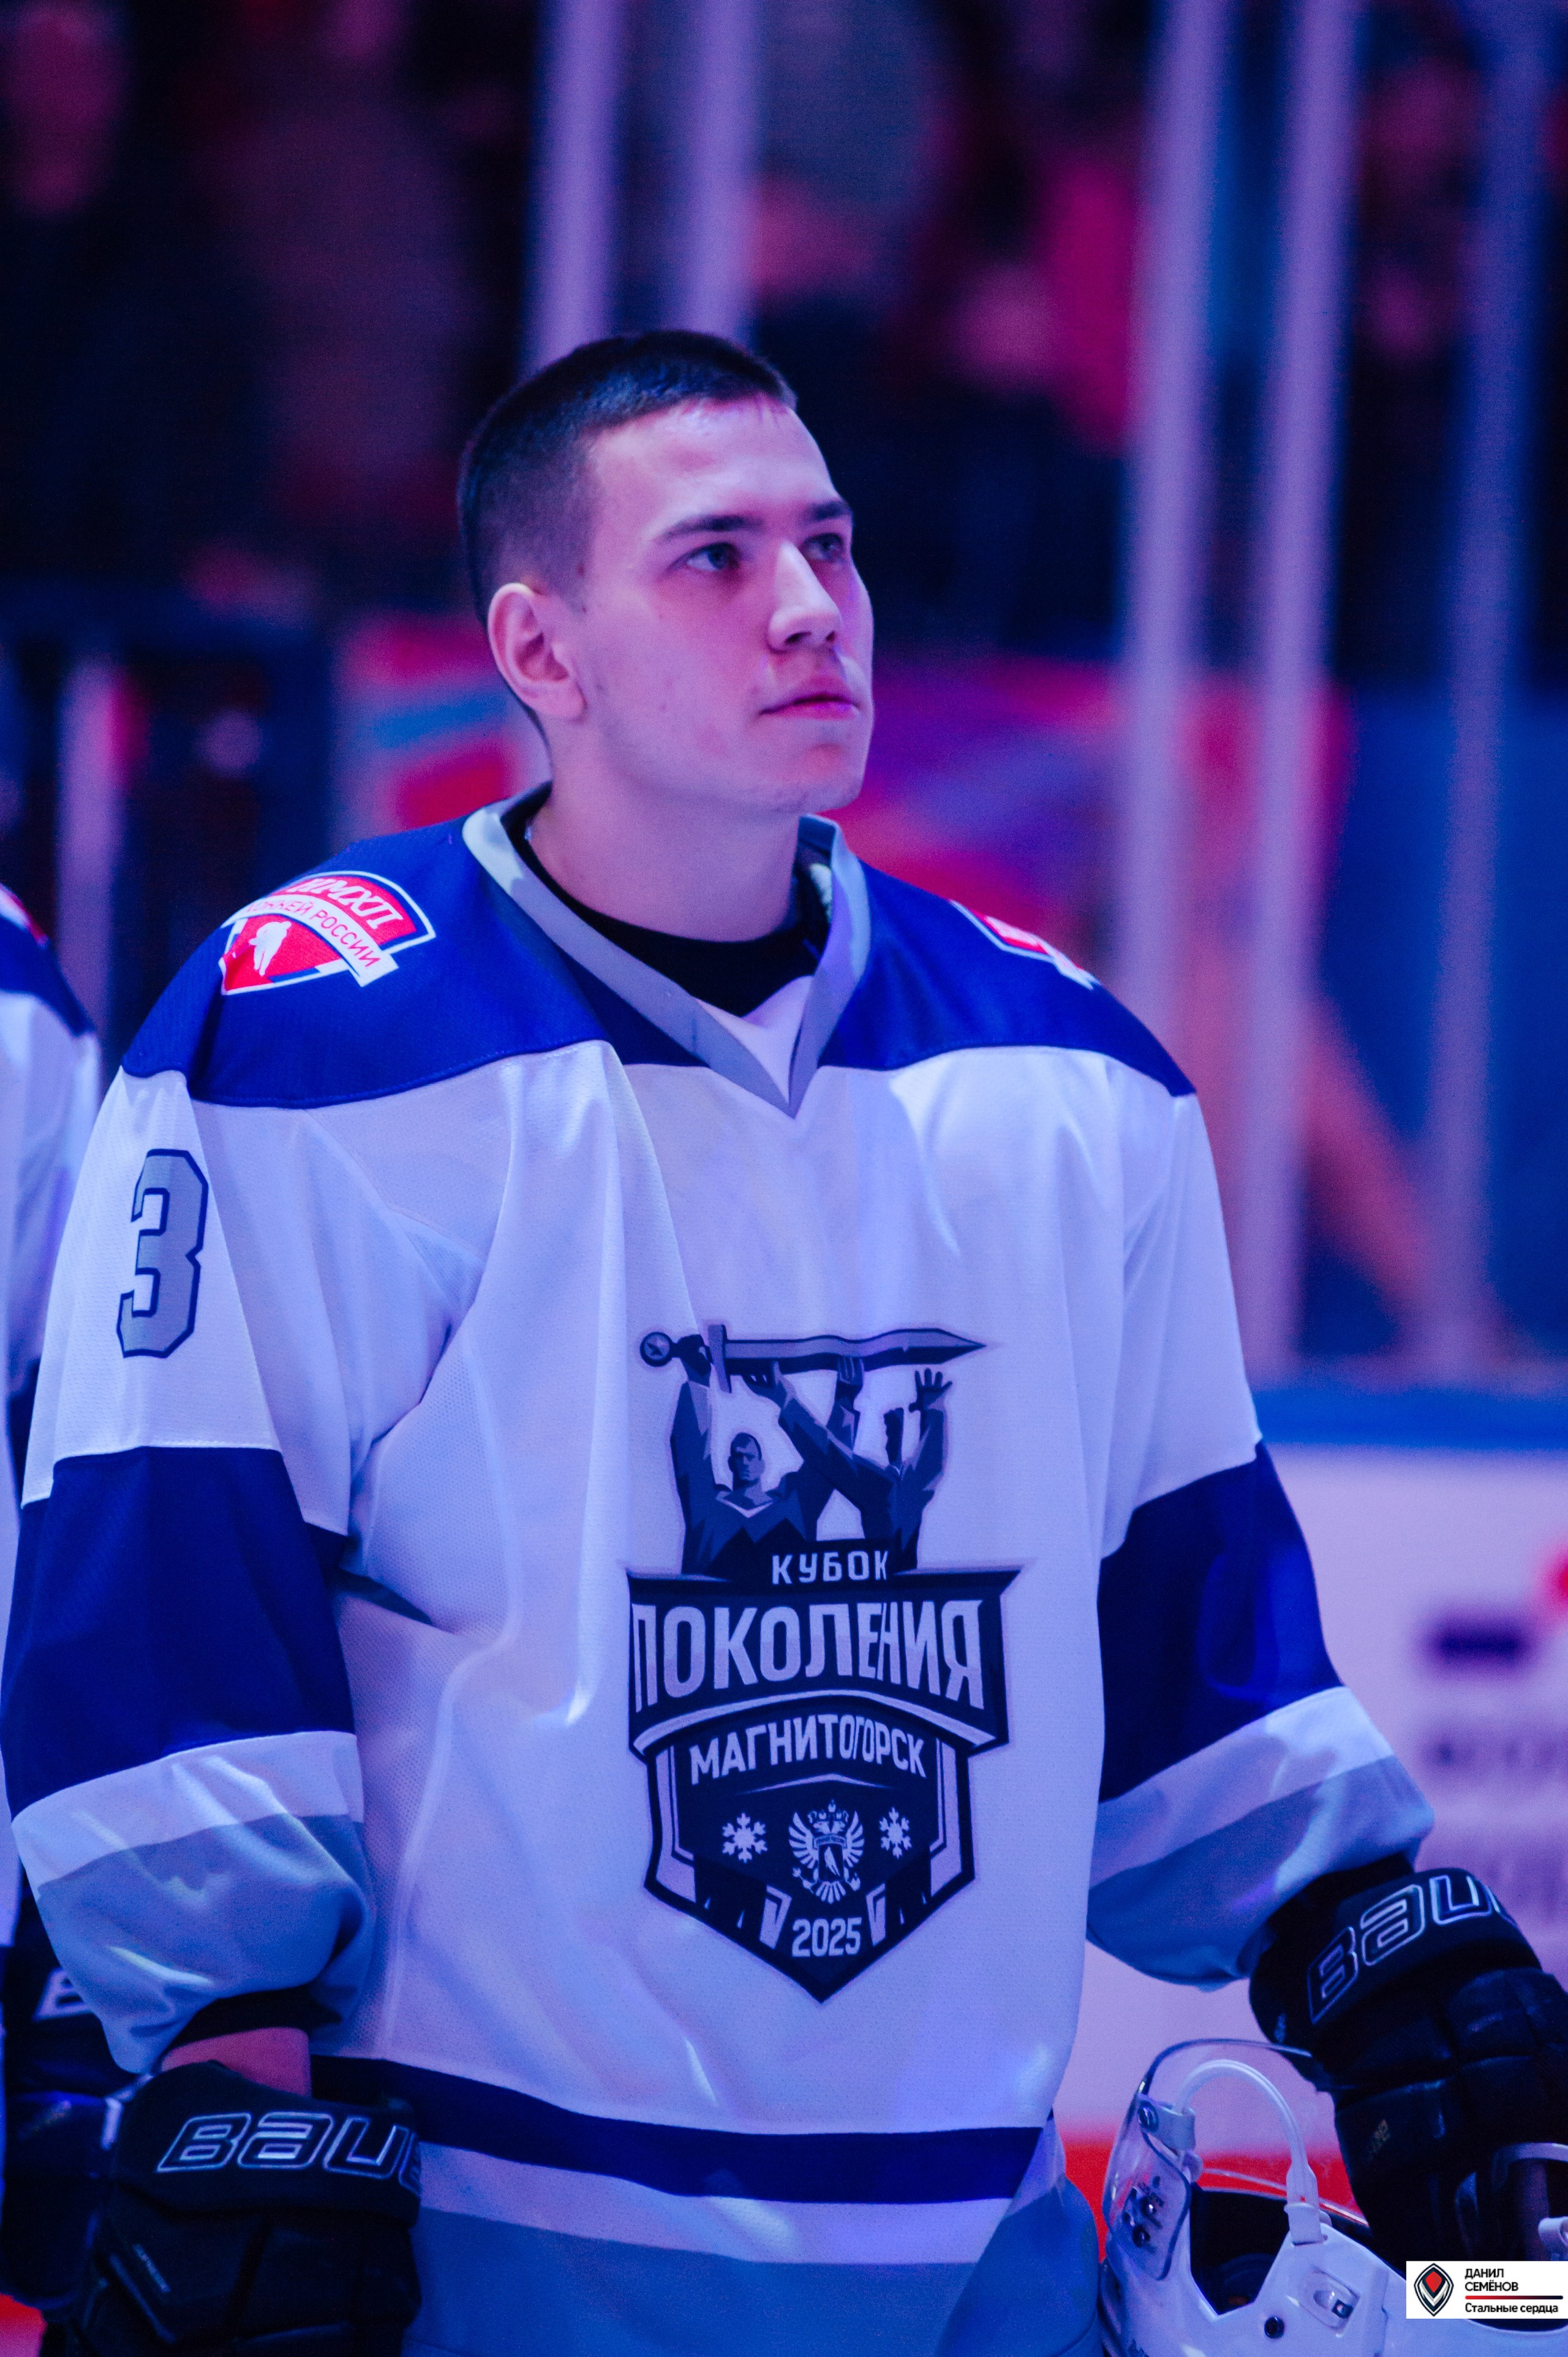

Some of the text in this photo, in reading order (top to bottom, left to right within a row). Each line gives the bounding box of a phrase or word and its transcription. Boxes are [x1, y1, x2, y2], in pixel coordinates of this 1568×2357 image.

[309, 909, 381, 967] РОССИИ
[116, 1148, 209, 1358] 3
[771, 1549, 889, 1585] КУБОК
[631, 1598, 985, 1713] ПОКОЛЕНИЯ
[690, 1714, 927, 1785] МАГНИТОГОРСК
[792, 1918, 862, 1958] 2025
[1307, 1874, 1518, 2024] BAU
